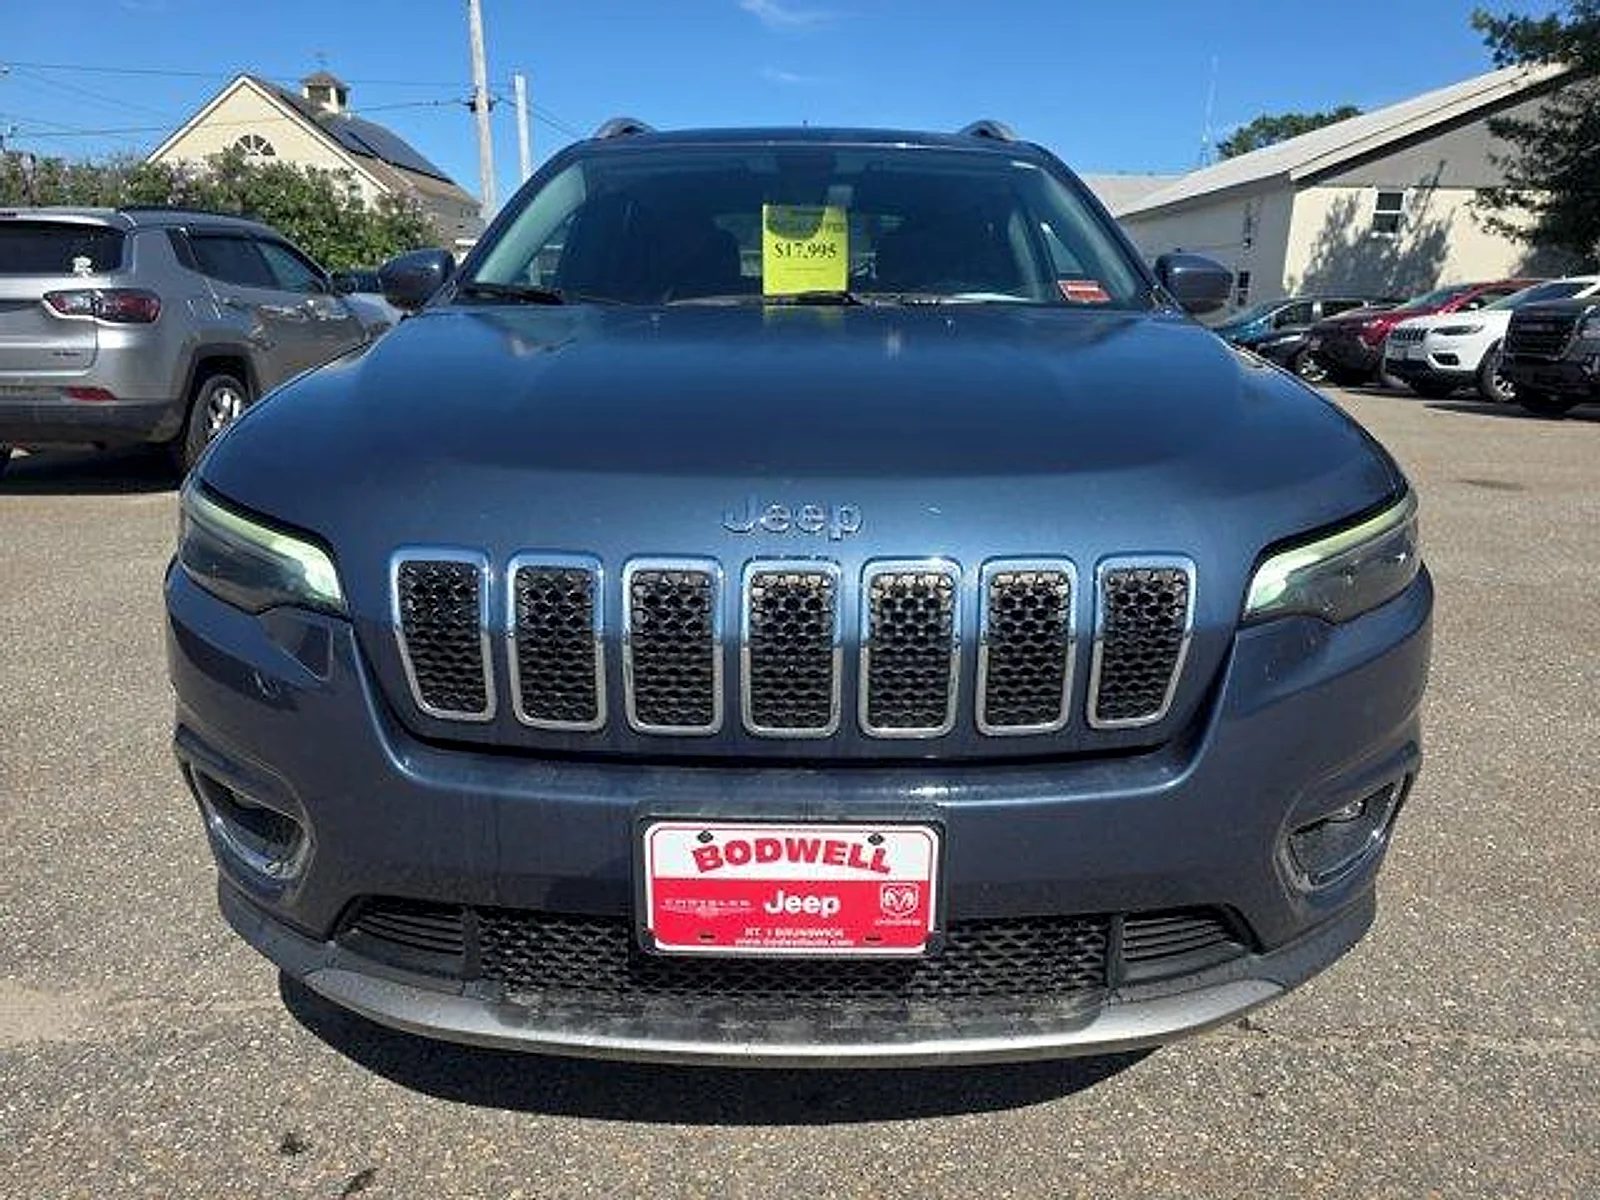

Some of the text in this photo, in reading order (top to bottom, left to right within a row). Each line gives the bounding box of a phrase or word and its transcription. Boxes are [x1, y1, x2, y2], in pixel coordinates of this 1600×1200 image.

[721, 494, 863, 541] Jeep
[692, 838, 891, 874] BODWELL
[764, 890, 841, 918] Jeep
